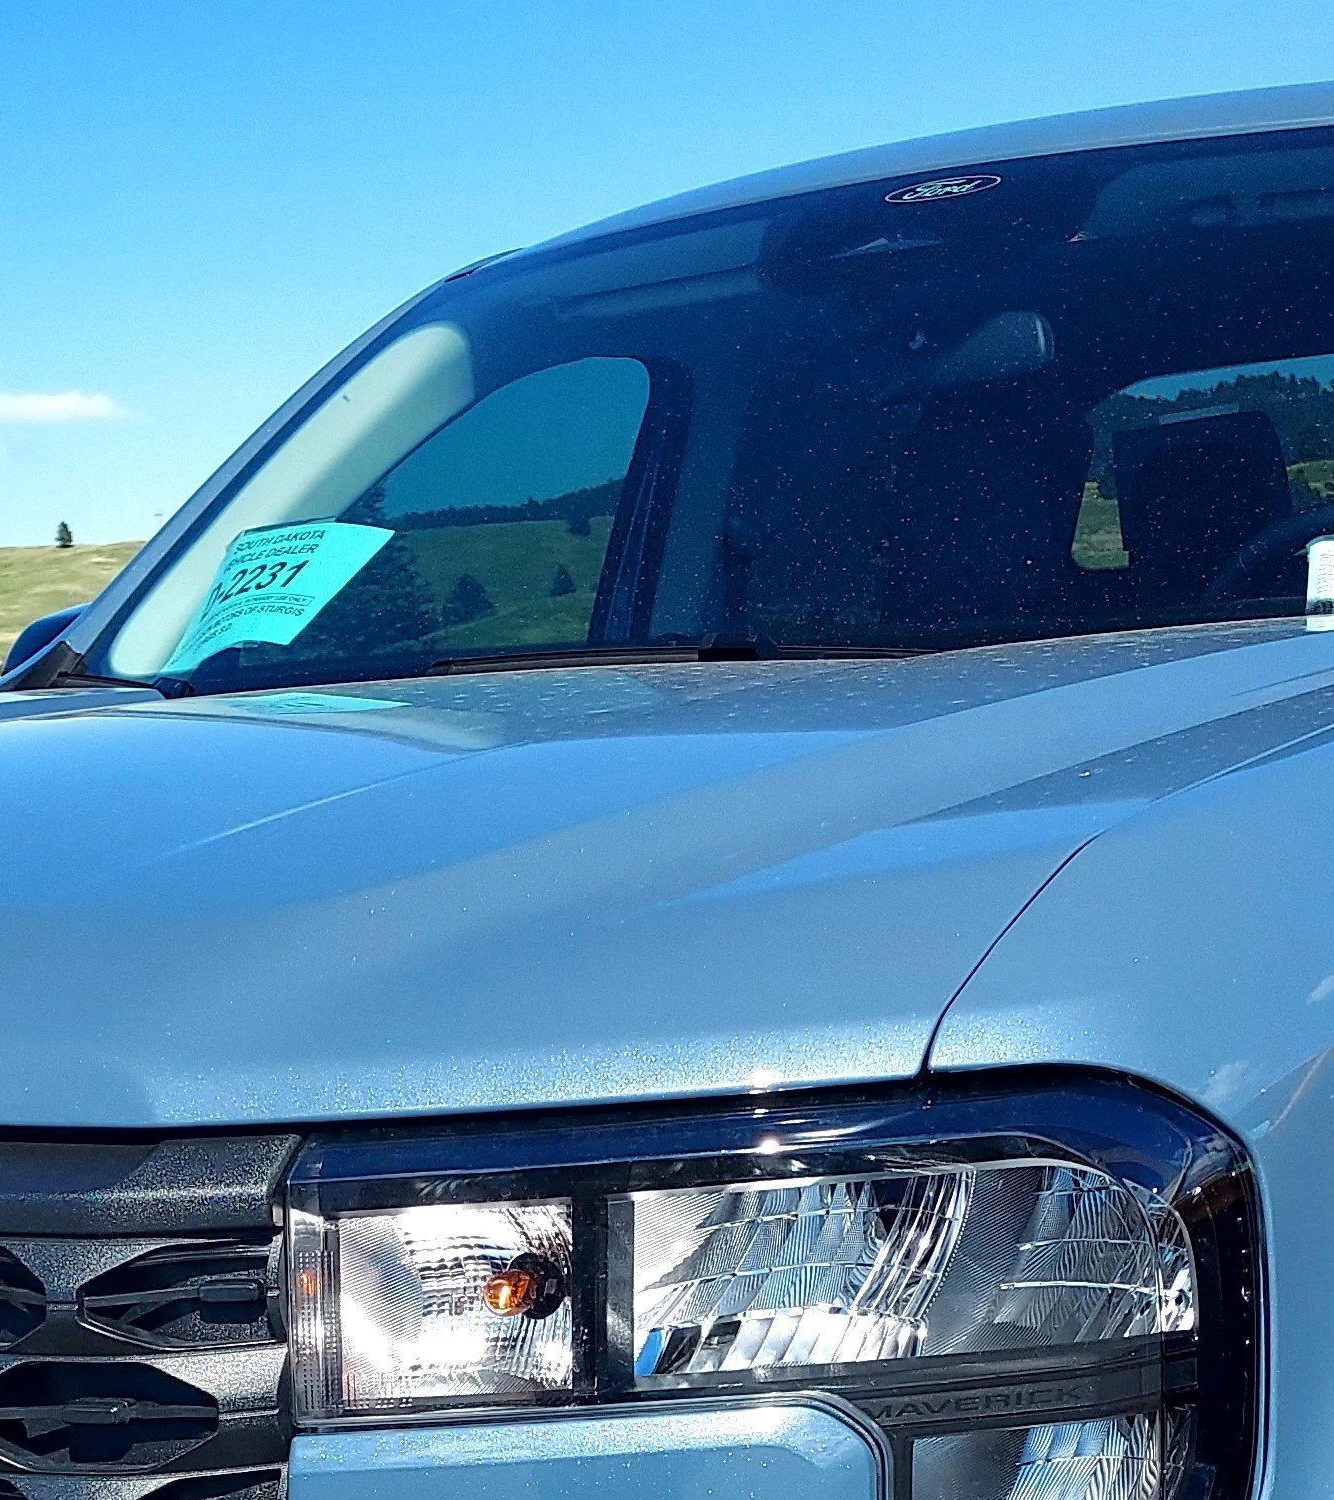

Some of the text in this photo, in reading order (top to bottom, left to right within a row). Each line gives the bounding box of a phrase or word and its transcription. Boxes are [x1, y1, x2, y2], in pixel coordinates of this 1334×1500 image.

[902, 178, 984, 200] Ford
[272, 529, 327, 545] DAKOTA
[264, 543, 320, 559] DEALER
[861, 1385, 1087, 1421] MAVERICK
